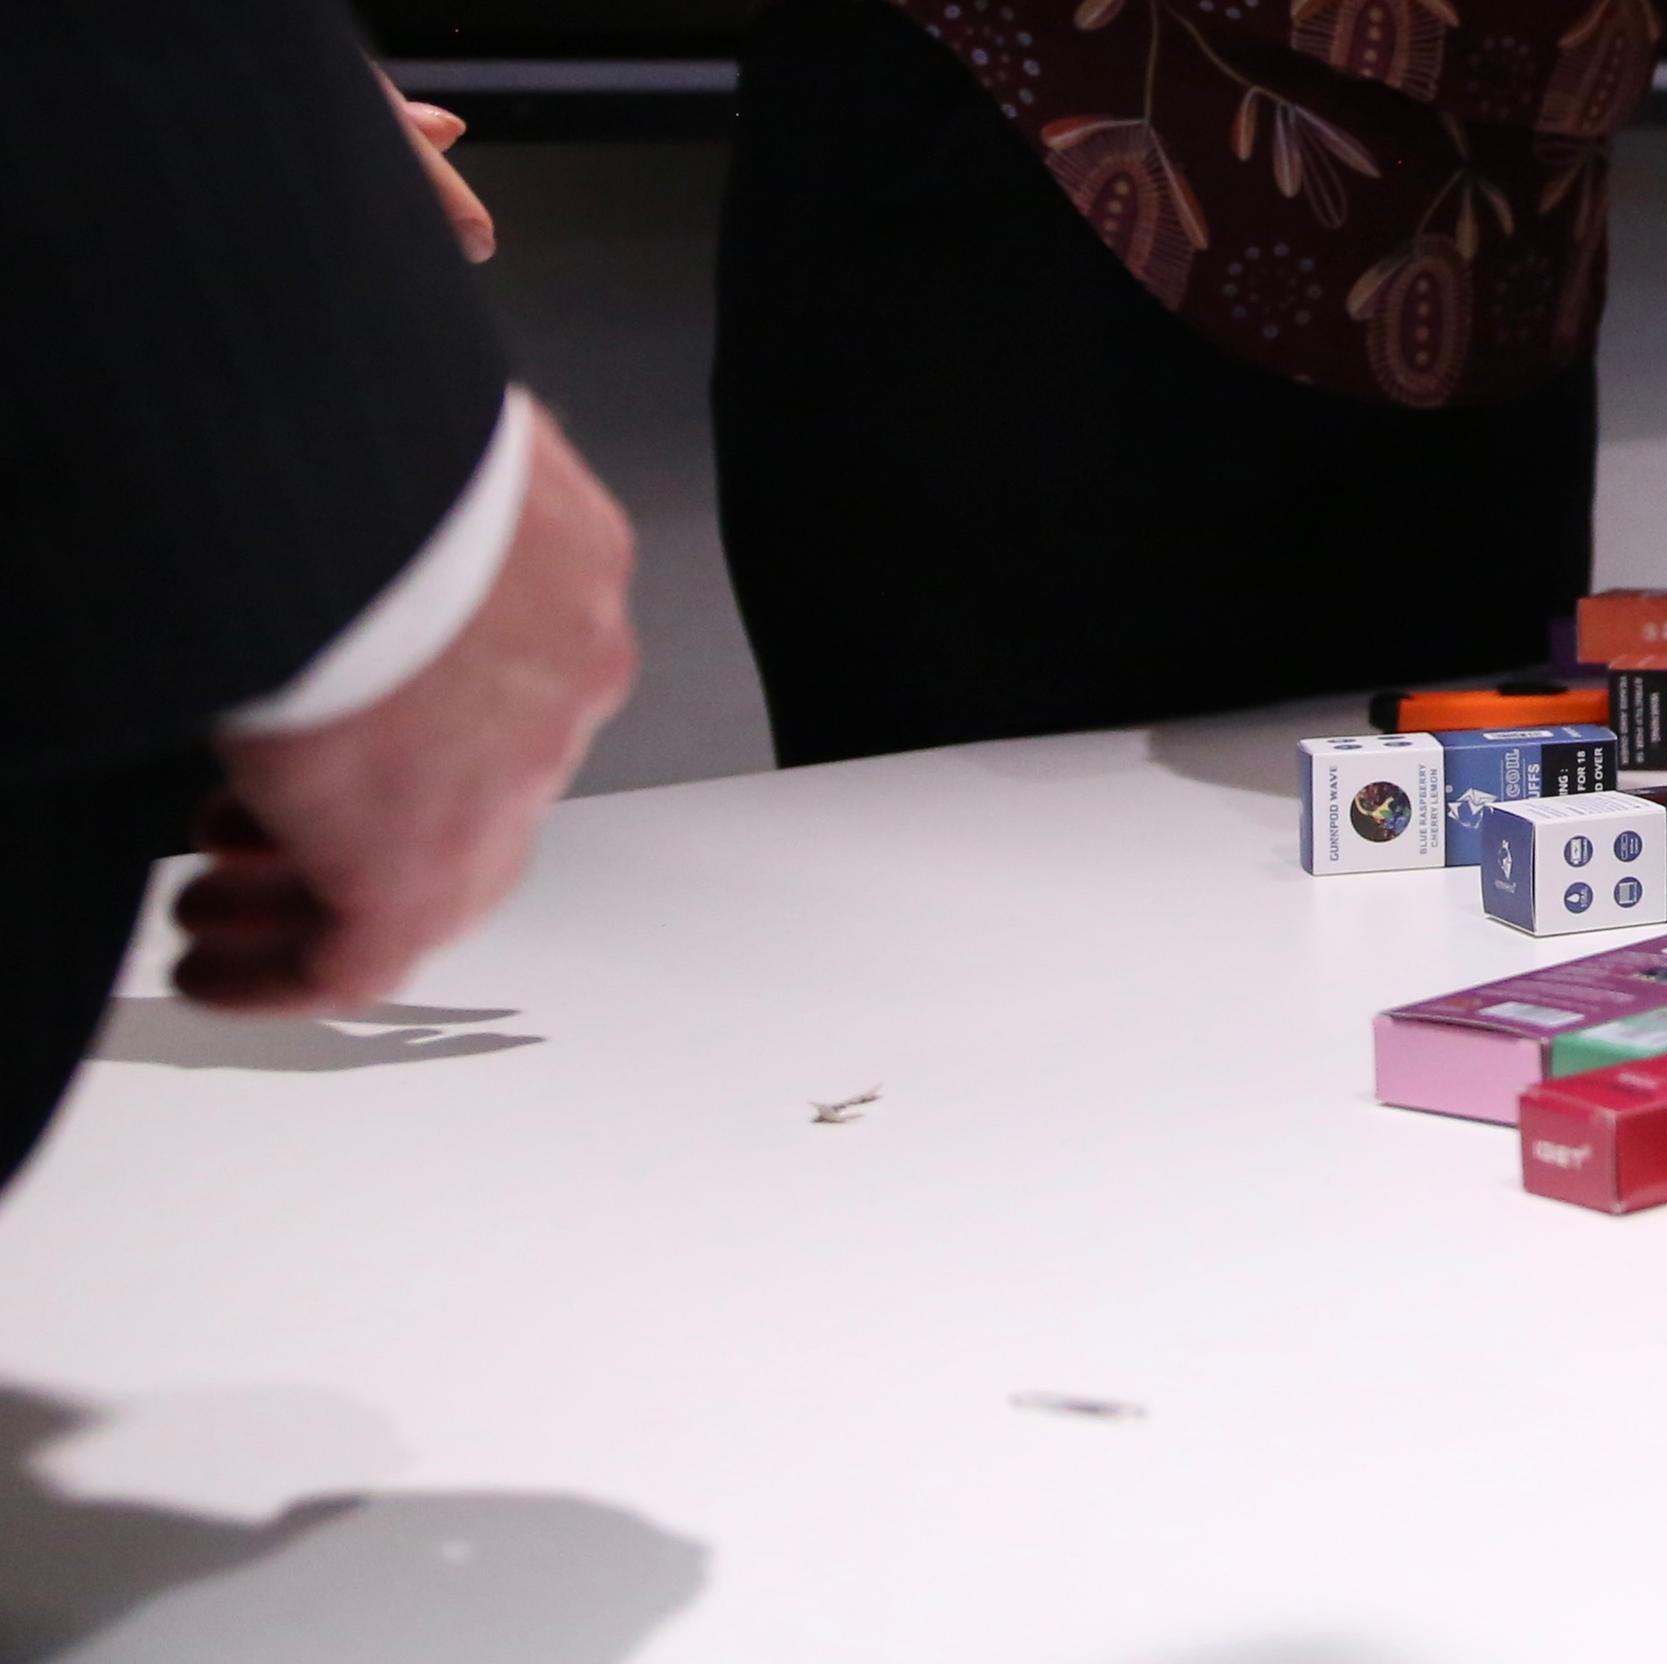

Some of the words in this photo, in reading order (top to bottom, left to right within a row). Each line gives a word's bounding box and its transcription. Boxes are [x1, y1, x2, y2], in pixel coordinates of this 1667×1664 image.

[1576, 750, 1586, 765] 18
[1594, 747, 1603, 782] OVER
[1329, 764, 1339, 799] WAVE
[1418, 764, 1427, 826] RASPBERRY
[1430, 768, 1439, 808] LEMON
[1576, 767, 1587, 792] FOR
[1329, 800, 1340, 862] GUNNPOD
[1418, 826, 1428, 855] BLUE
[1430, 808, 1439, 849] CHERRY
